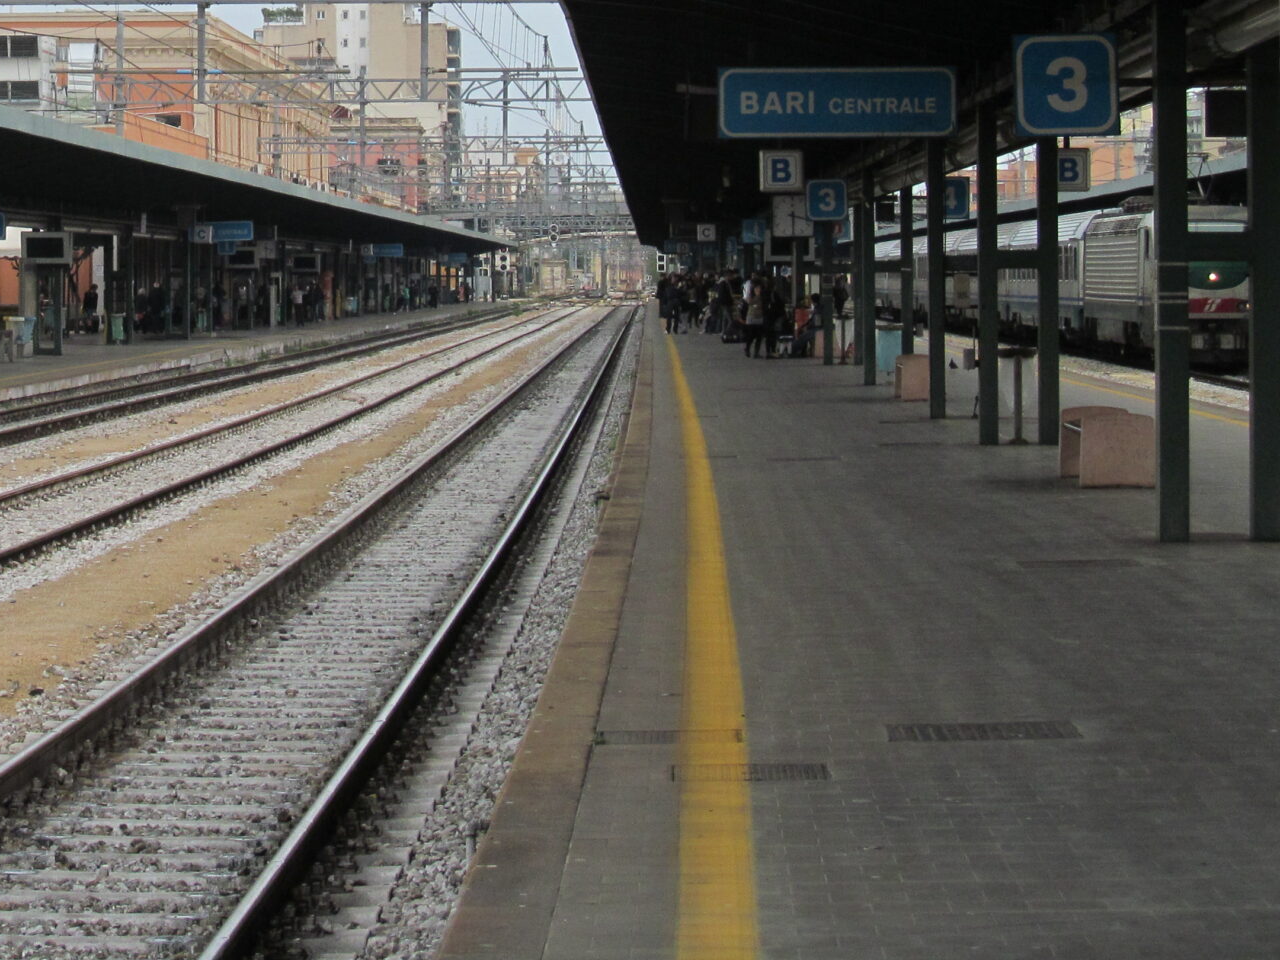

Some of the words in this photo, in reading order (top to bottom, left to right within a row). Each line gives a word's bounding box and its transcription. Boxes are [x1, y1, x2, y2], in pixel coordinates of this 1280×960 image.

[1046, 56, 1088, 113] 3
[739, 90, 815, 114] BARI
[828, 98, 937, 114] CENTRALE
[771, 158, 792, 183] B
[1058, 158, 1079, 182] B
[818, 188, 836, 212] 3
[199, 230, 207, 239] C
[702, 228, 711, 238] C
